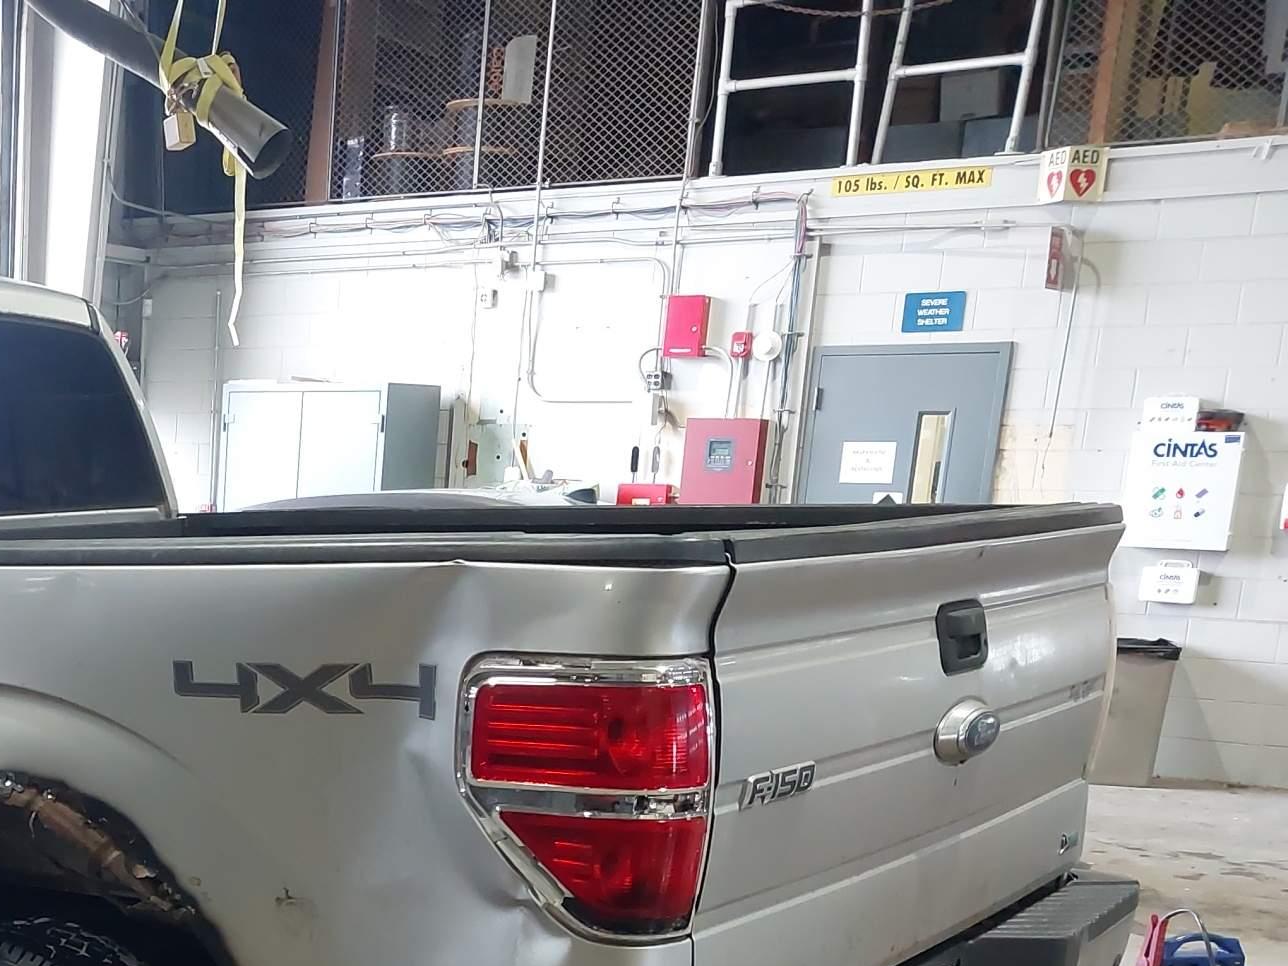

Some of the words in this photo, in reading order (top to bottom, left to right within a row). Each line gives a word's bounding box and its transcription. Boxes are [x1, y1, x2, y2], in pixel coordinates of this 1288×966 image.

[1048, 150, 1066, 167] AED
[1071, 148, 1100, 165] AED
[837, 179, 861, 194] 105
[865, 177, 888, 191] lbs.
[905, 174, 924, 189] SQ.
[931, 172, 948, 187] FT.
[955, 169, 985, 185] MAX
[920, 298, 948, 307] SEVERE
[917, 307, 950, 317] WEATHER
[917, 317, 947, 327] SHELTER
